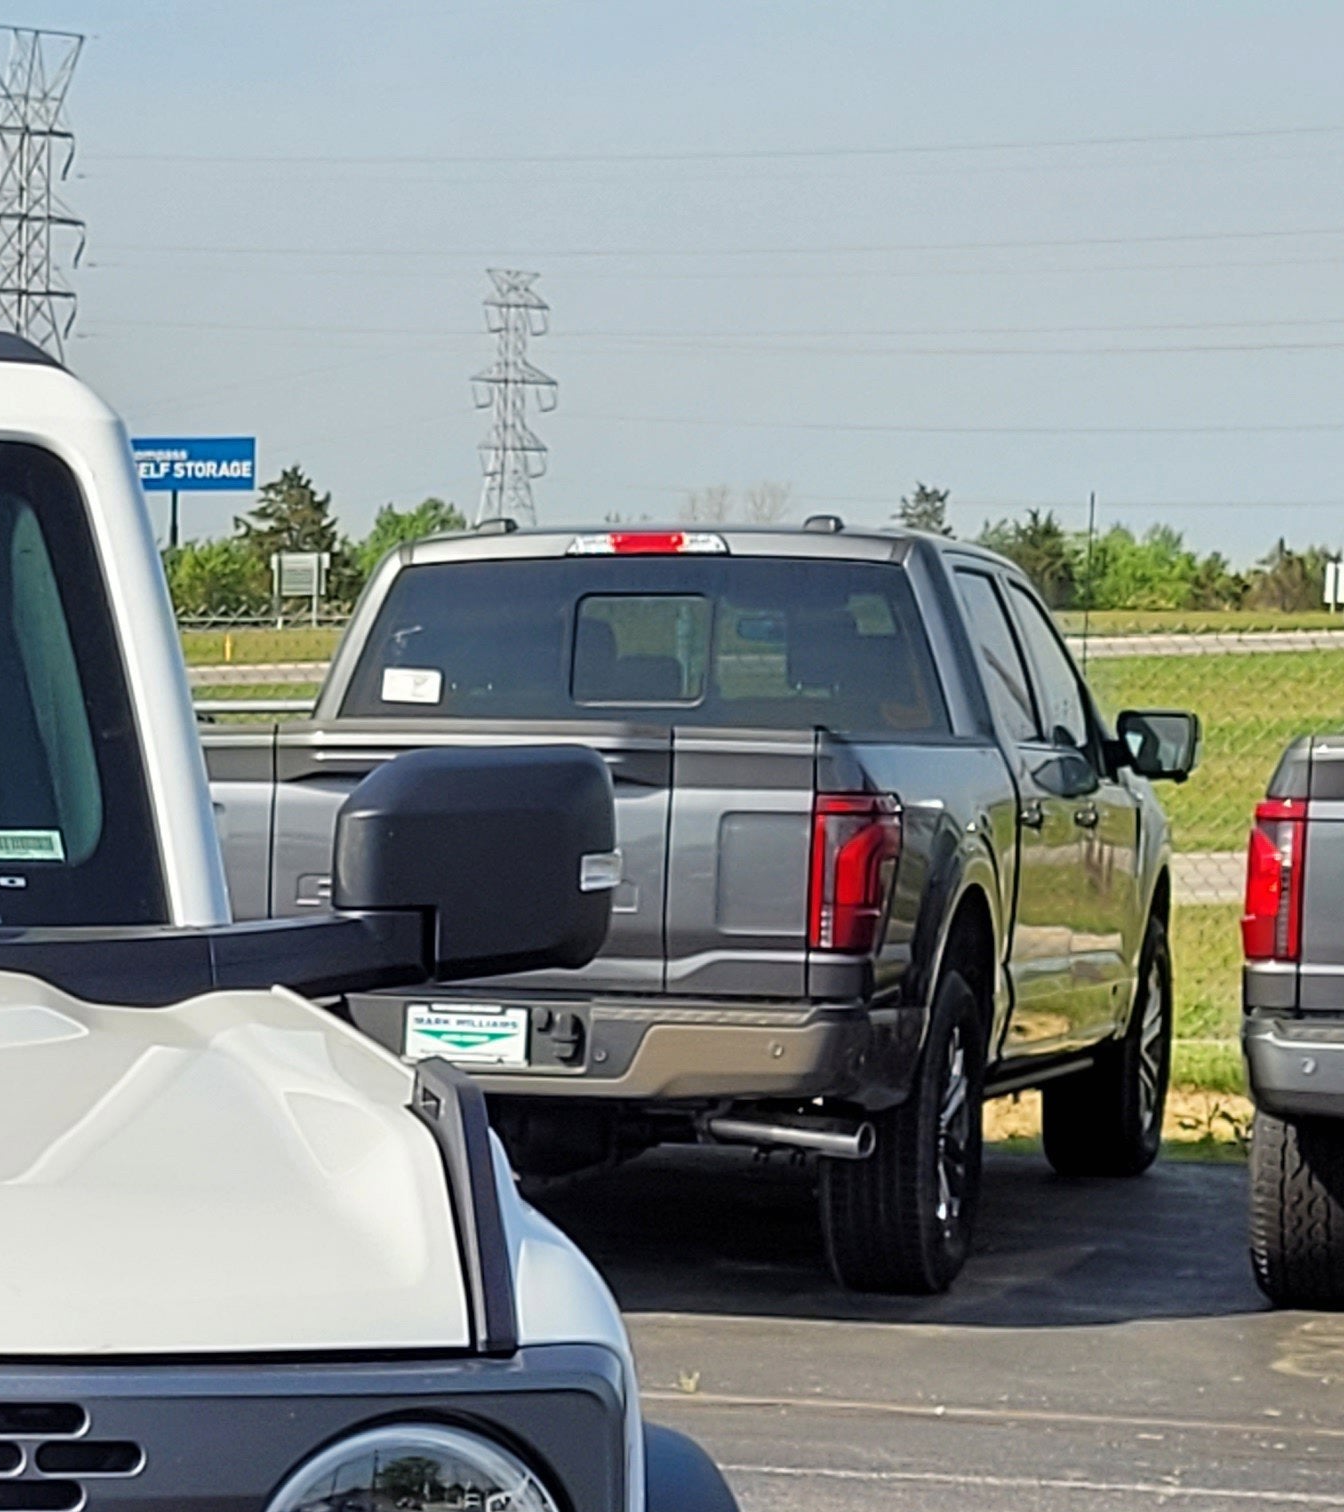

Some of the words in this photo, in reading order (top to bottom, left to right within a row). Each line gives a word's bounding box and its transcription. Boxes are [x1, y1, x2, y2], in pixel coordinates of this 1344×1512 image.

[138, 460, 171, 479] ELF
[173, 460, 252, 479] STORAGE
[414, 1016, 450, 1026] MARK
[455, 1018, 519, 1029] WILLIAMS
